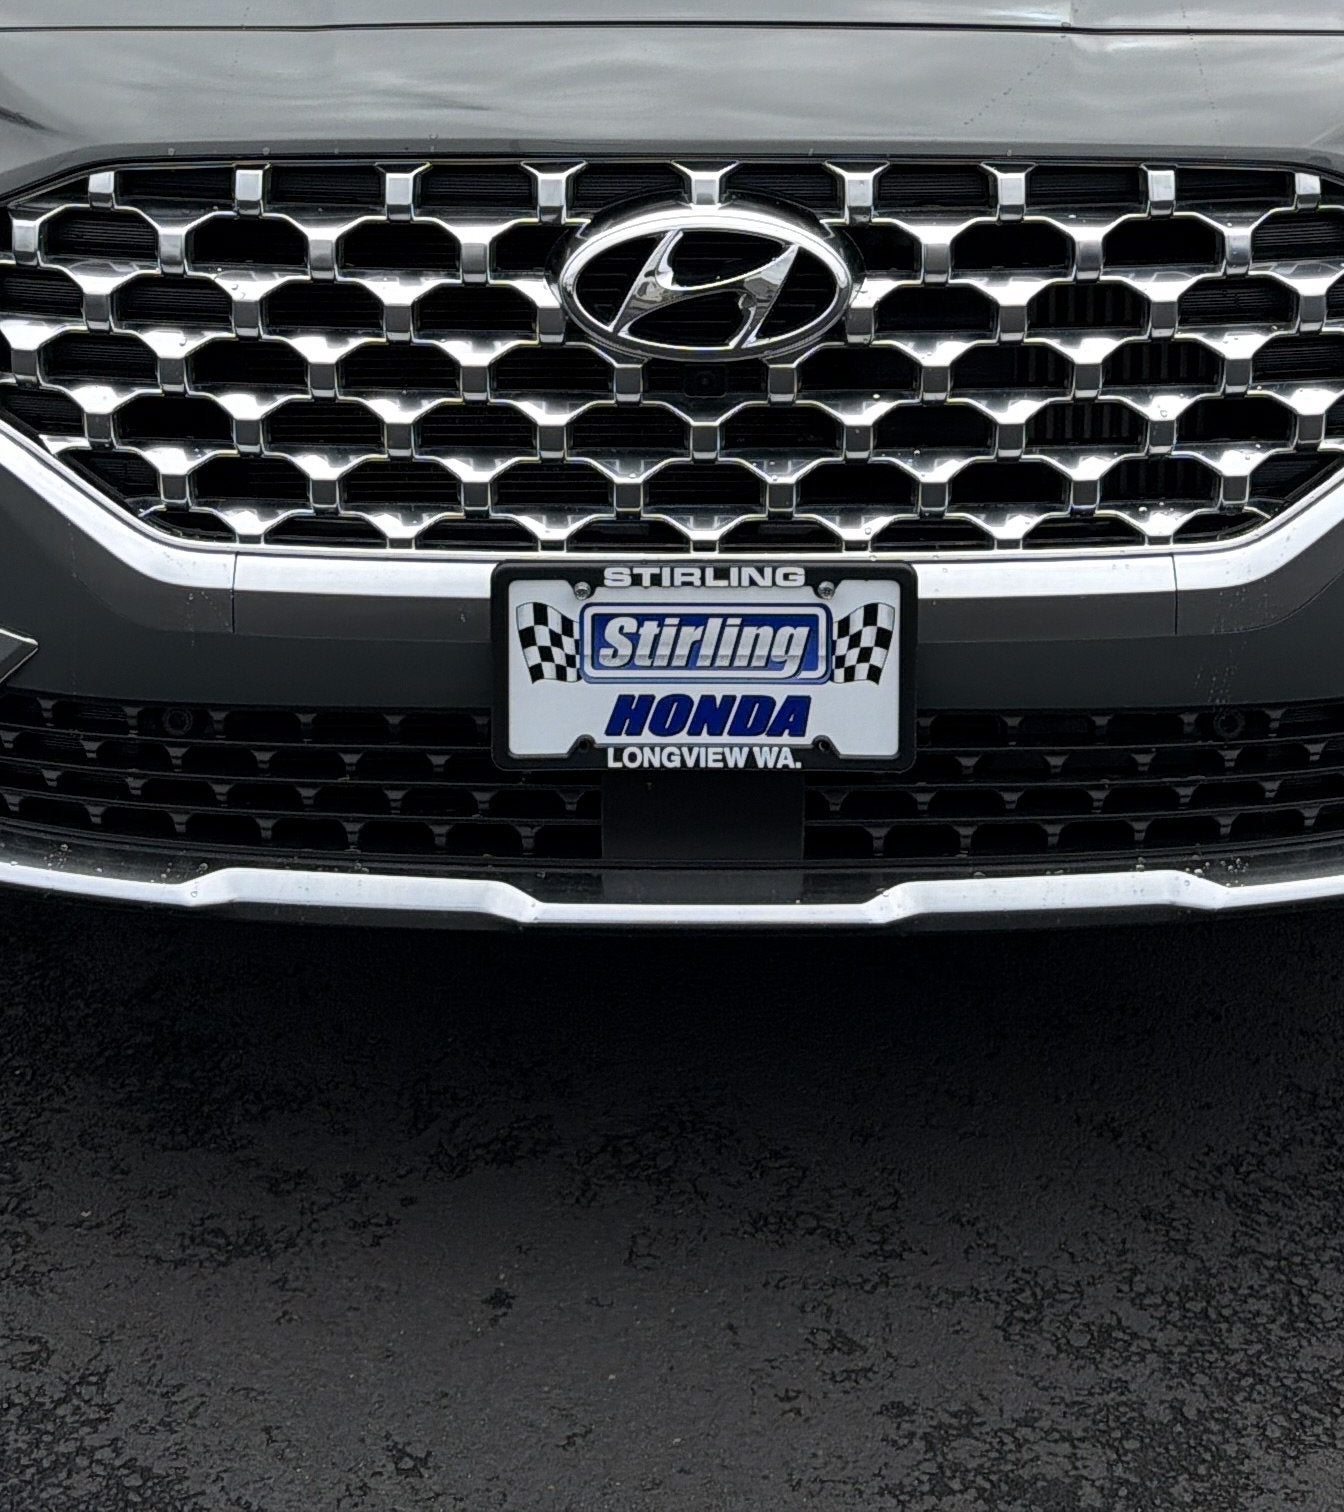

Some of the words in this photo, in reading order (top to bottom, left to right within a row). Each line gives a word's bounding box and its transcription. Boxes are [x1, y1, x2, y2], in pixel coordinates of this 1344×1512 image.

[603, 566, 806, 588] STIRLING
[598, 616, 810, 679] Stirling
[604, 694, 812, 738] HONDA
[607, 746, 754, 769] LONGVIEW
[753, 746, 802, 769] WA.
